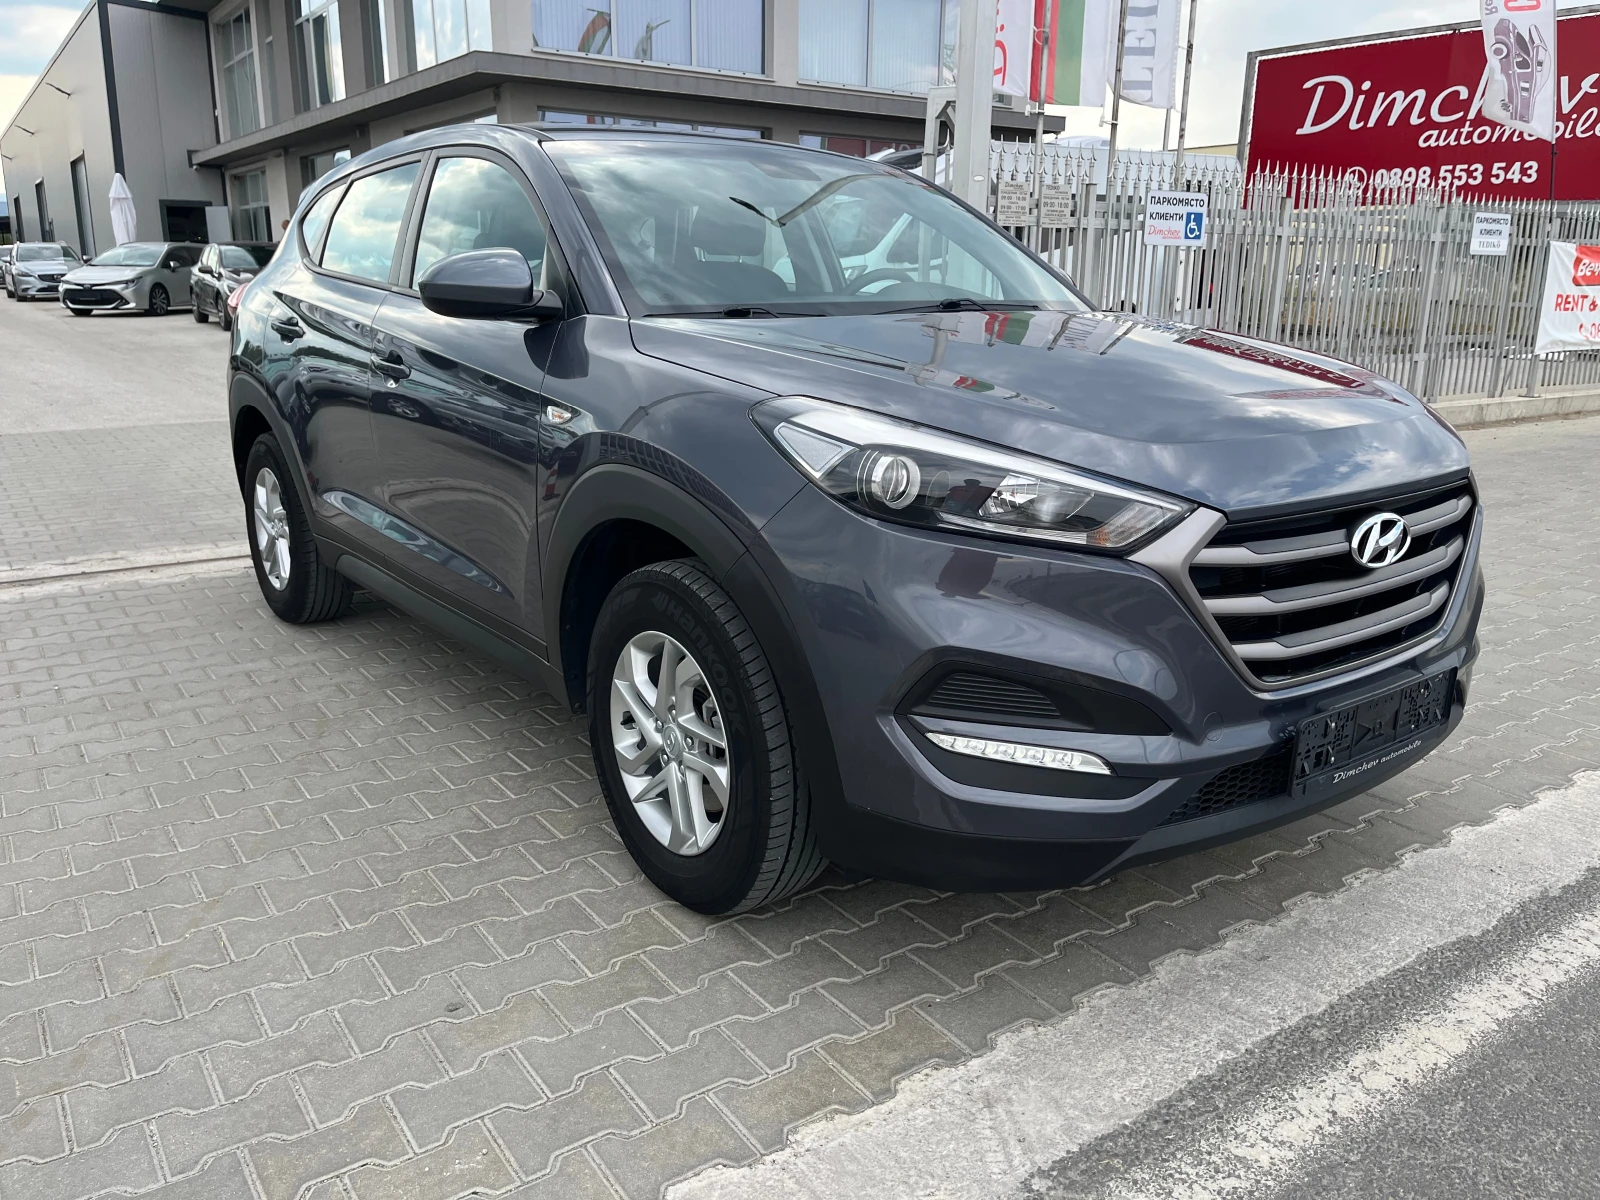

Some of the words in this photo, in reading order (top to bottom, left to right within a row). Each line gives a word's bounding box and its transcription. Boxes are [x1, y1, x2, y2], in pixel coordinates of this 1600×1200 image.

[1375, 166, 1431, 190] 0898
[1438, 163, 1483, 187] 553
[1490, 160, 1538, 185] 543
[1150, 195, 1205, 208] ПАРКОМЯСТО
[1149, 211, 1184, 221] КЛИЕНТИ
[1475, 216, 1509, 226] ПАРКОМЯСТО
[1148, 224, 1181, 236] Dimchev
[1554, 293, 1589, 312] RENT
[1588, 294, 1599, 312] &
[1332, 759, 1379, 784] Dimchev
